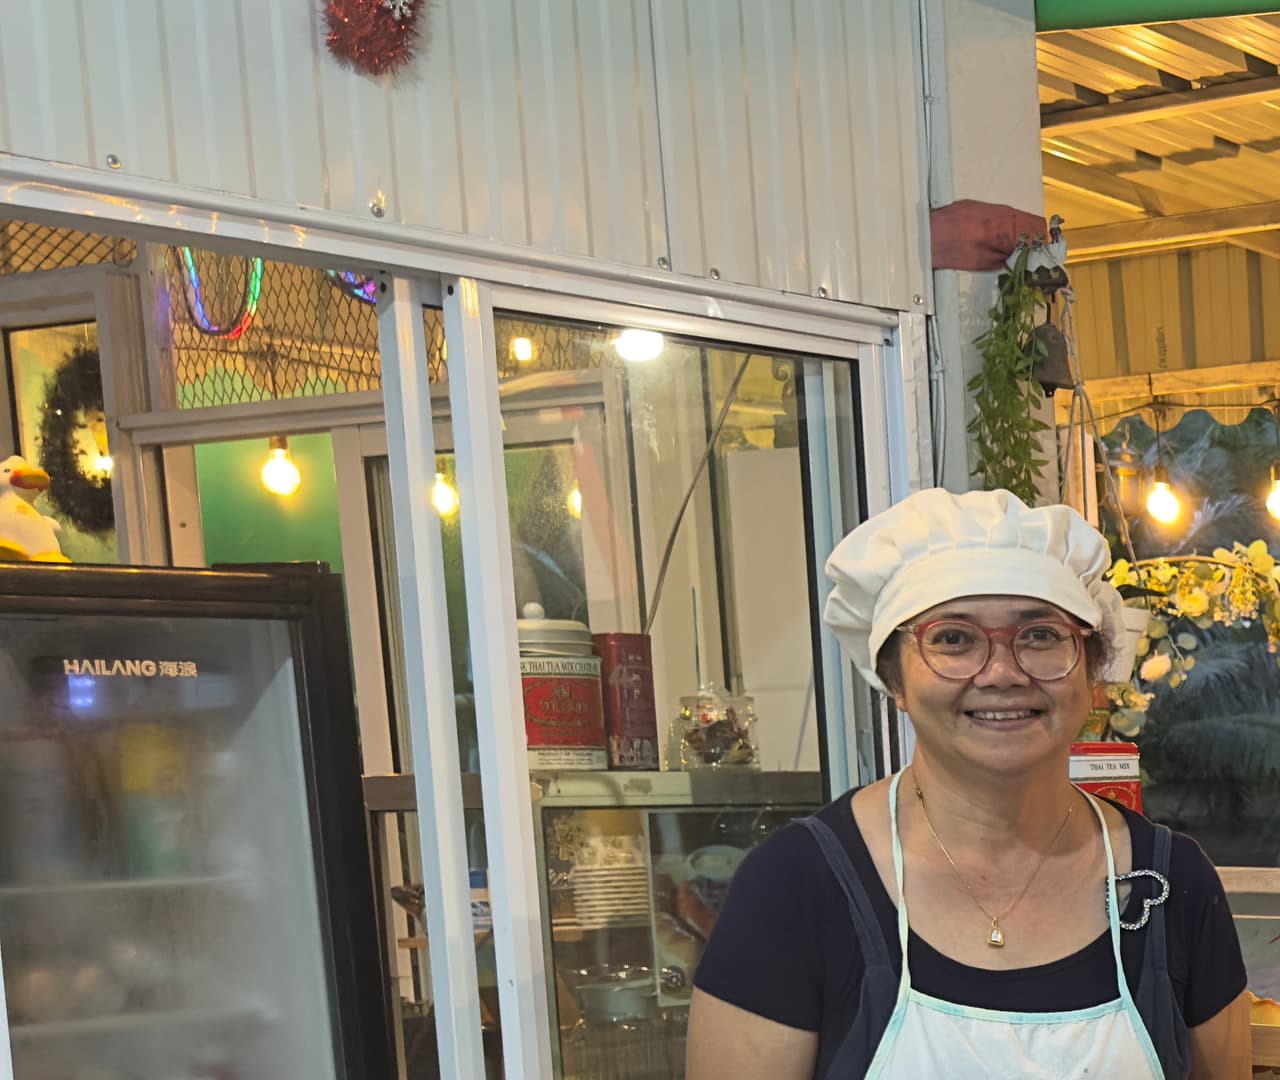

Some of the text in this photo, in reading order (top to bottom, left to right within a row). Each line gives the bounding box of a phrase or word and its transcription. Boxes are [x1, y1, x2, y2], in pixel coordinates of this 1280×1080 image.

[63, 659, 197, 677] HAILANG 海浪
[1090, 763, 1104, 771] THAI
